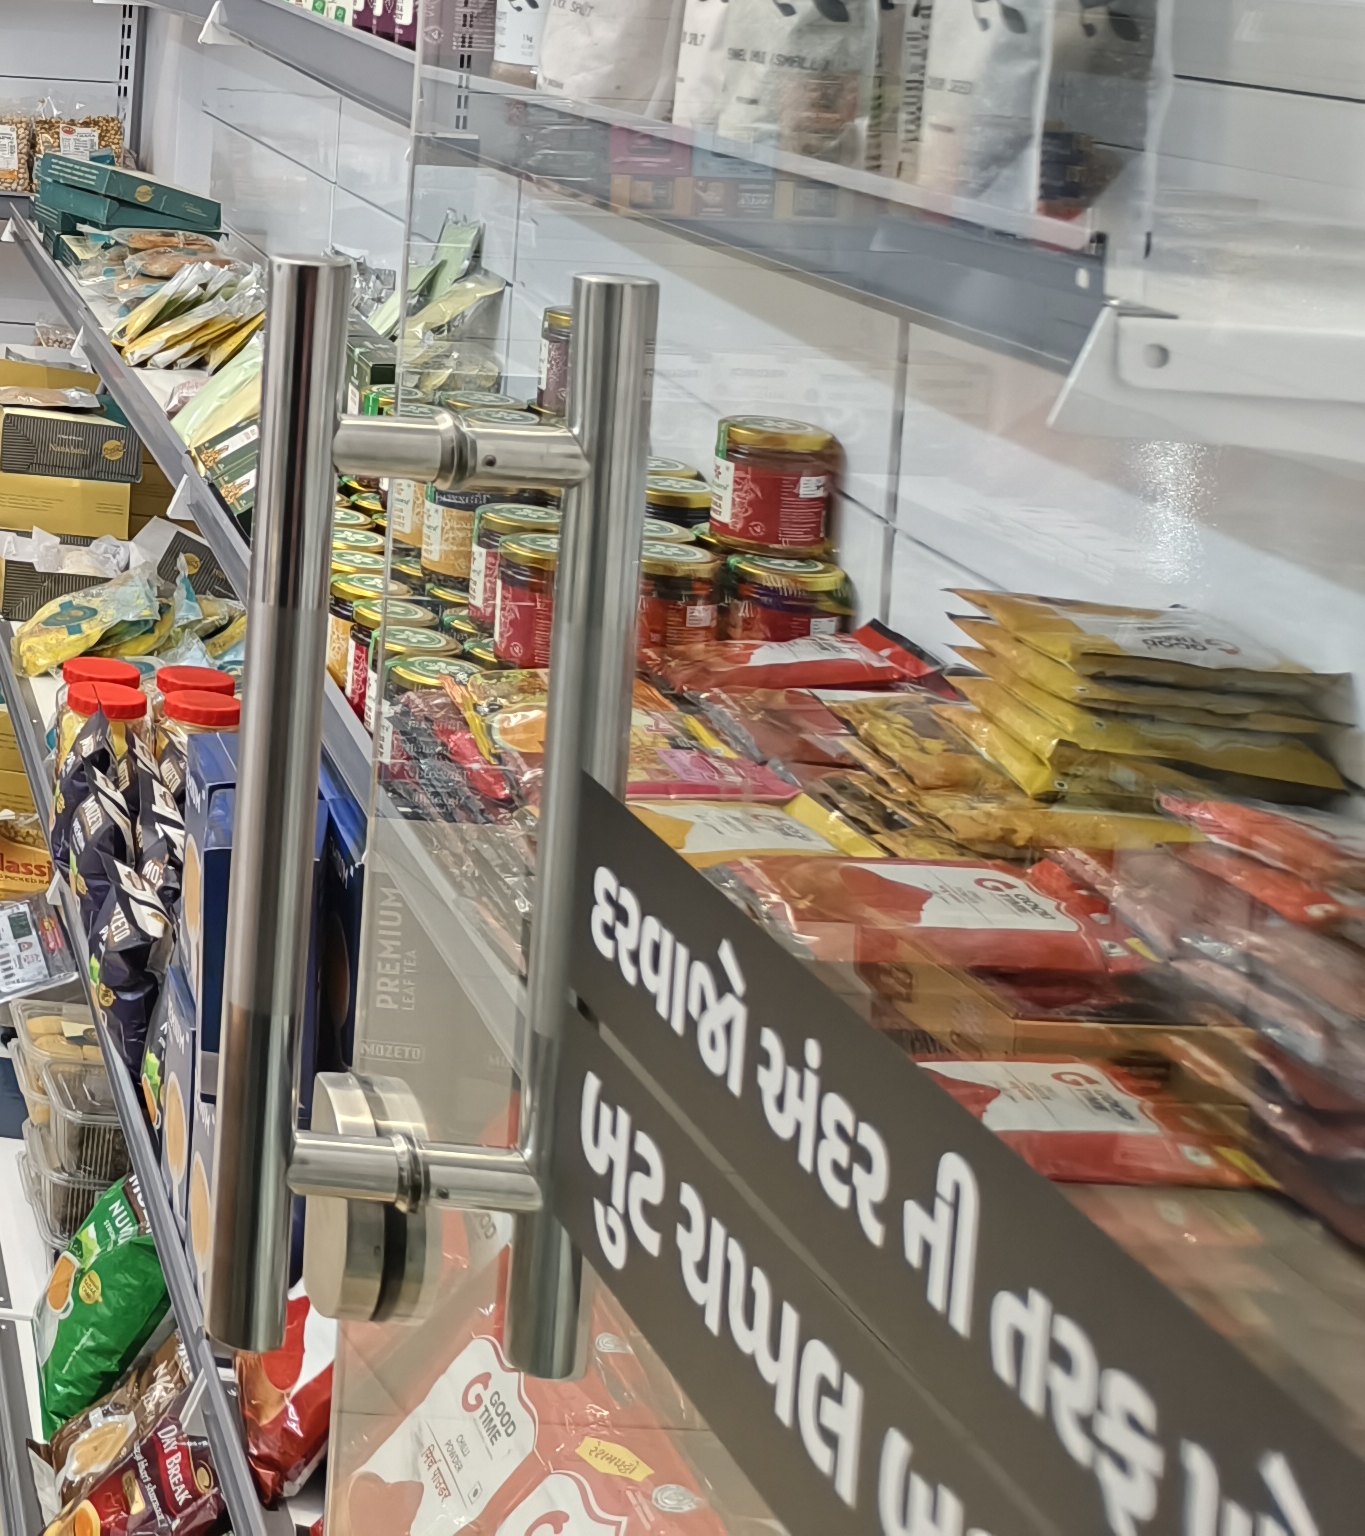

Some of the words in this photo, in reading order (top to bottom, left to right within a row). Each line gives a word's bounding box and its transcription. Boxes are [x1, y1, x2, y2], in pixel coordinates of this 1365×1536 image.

[82, 795, 103, 835] MOZETO
[375, 886, 403, 1010] PREMIUM
[402, 949, 418, 973] TEA
[401, 975, 415, 1011] LEAF
[360, 1041, 420, 1061] MOZETO
[757, 1026, 890, 1248] અંદર
[903, 1151, 980, 1339] ની
[477, 1404, 502, 1447] TIME
[489, 1390, 517, 1438] GOOD
[157, 1423, 178, 1455] DAY
[444, 1438, 464, 1474] POWDER
[165, 1454, 193, 1506] BREAK
